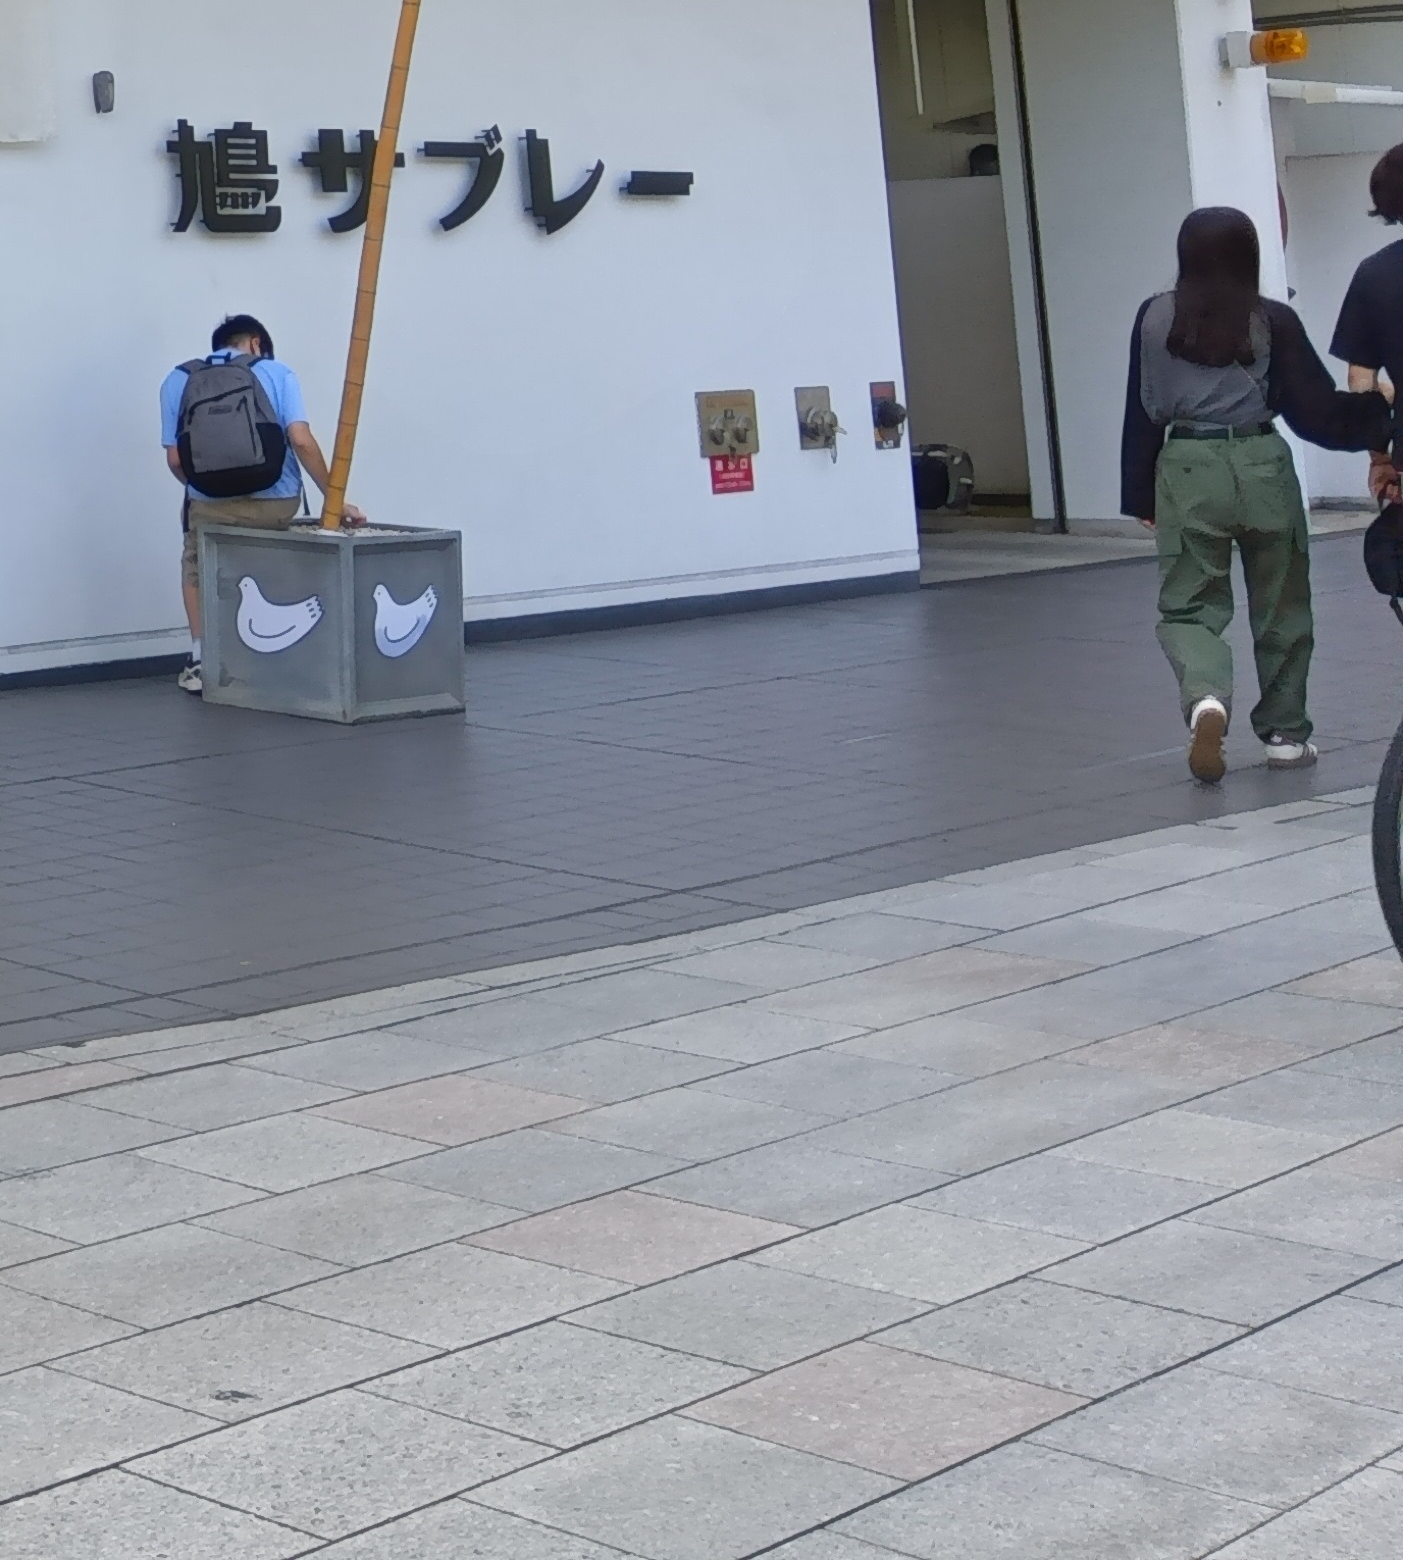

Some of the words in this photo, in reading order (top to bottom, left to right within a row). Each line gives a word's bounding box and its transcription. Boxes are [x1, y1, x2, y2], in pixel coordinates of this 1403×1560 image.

[166, 118, 694, 235] 鳩サブレー
